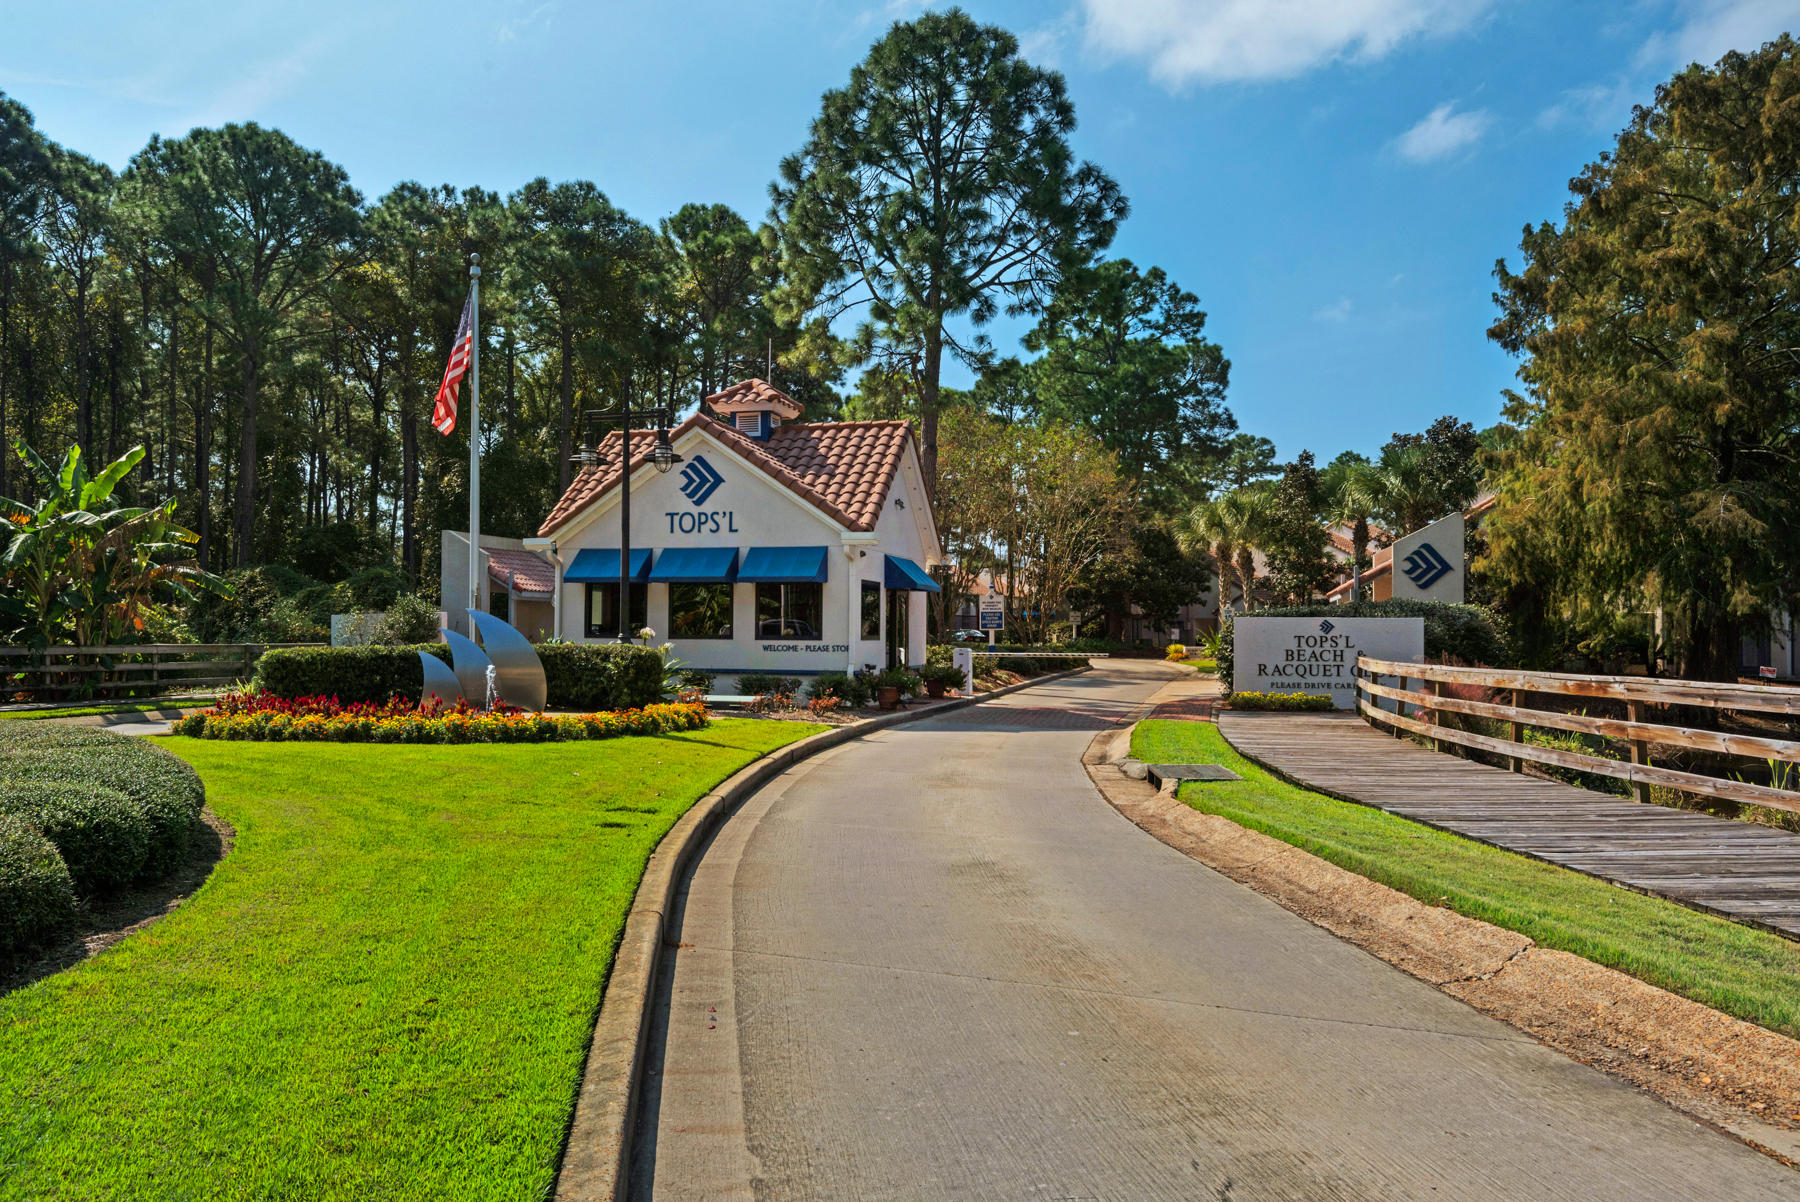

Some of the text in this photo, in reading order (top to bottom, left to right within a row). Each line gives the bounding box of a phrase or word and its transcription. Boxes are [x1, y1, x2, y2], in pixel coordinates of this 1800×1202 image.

[665, 511, 739, 534] TOPS'L
[762, 644, 799, 652] WELCOME
[1294, 635, 1355, 648] TOPS'L
[1285, 649, 1345, 662] BEACH
[1257, 663, 1345, 679] RACQUET
[1304, 682, 1332, 690] DRIVE
